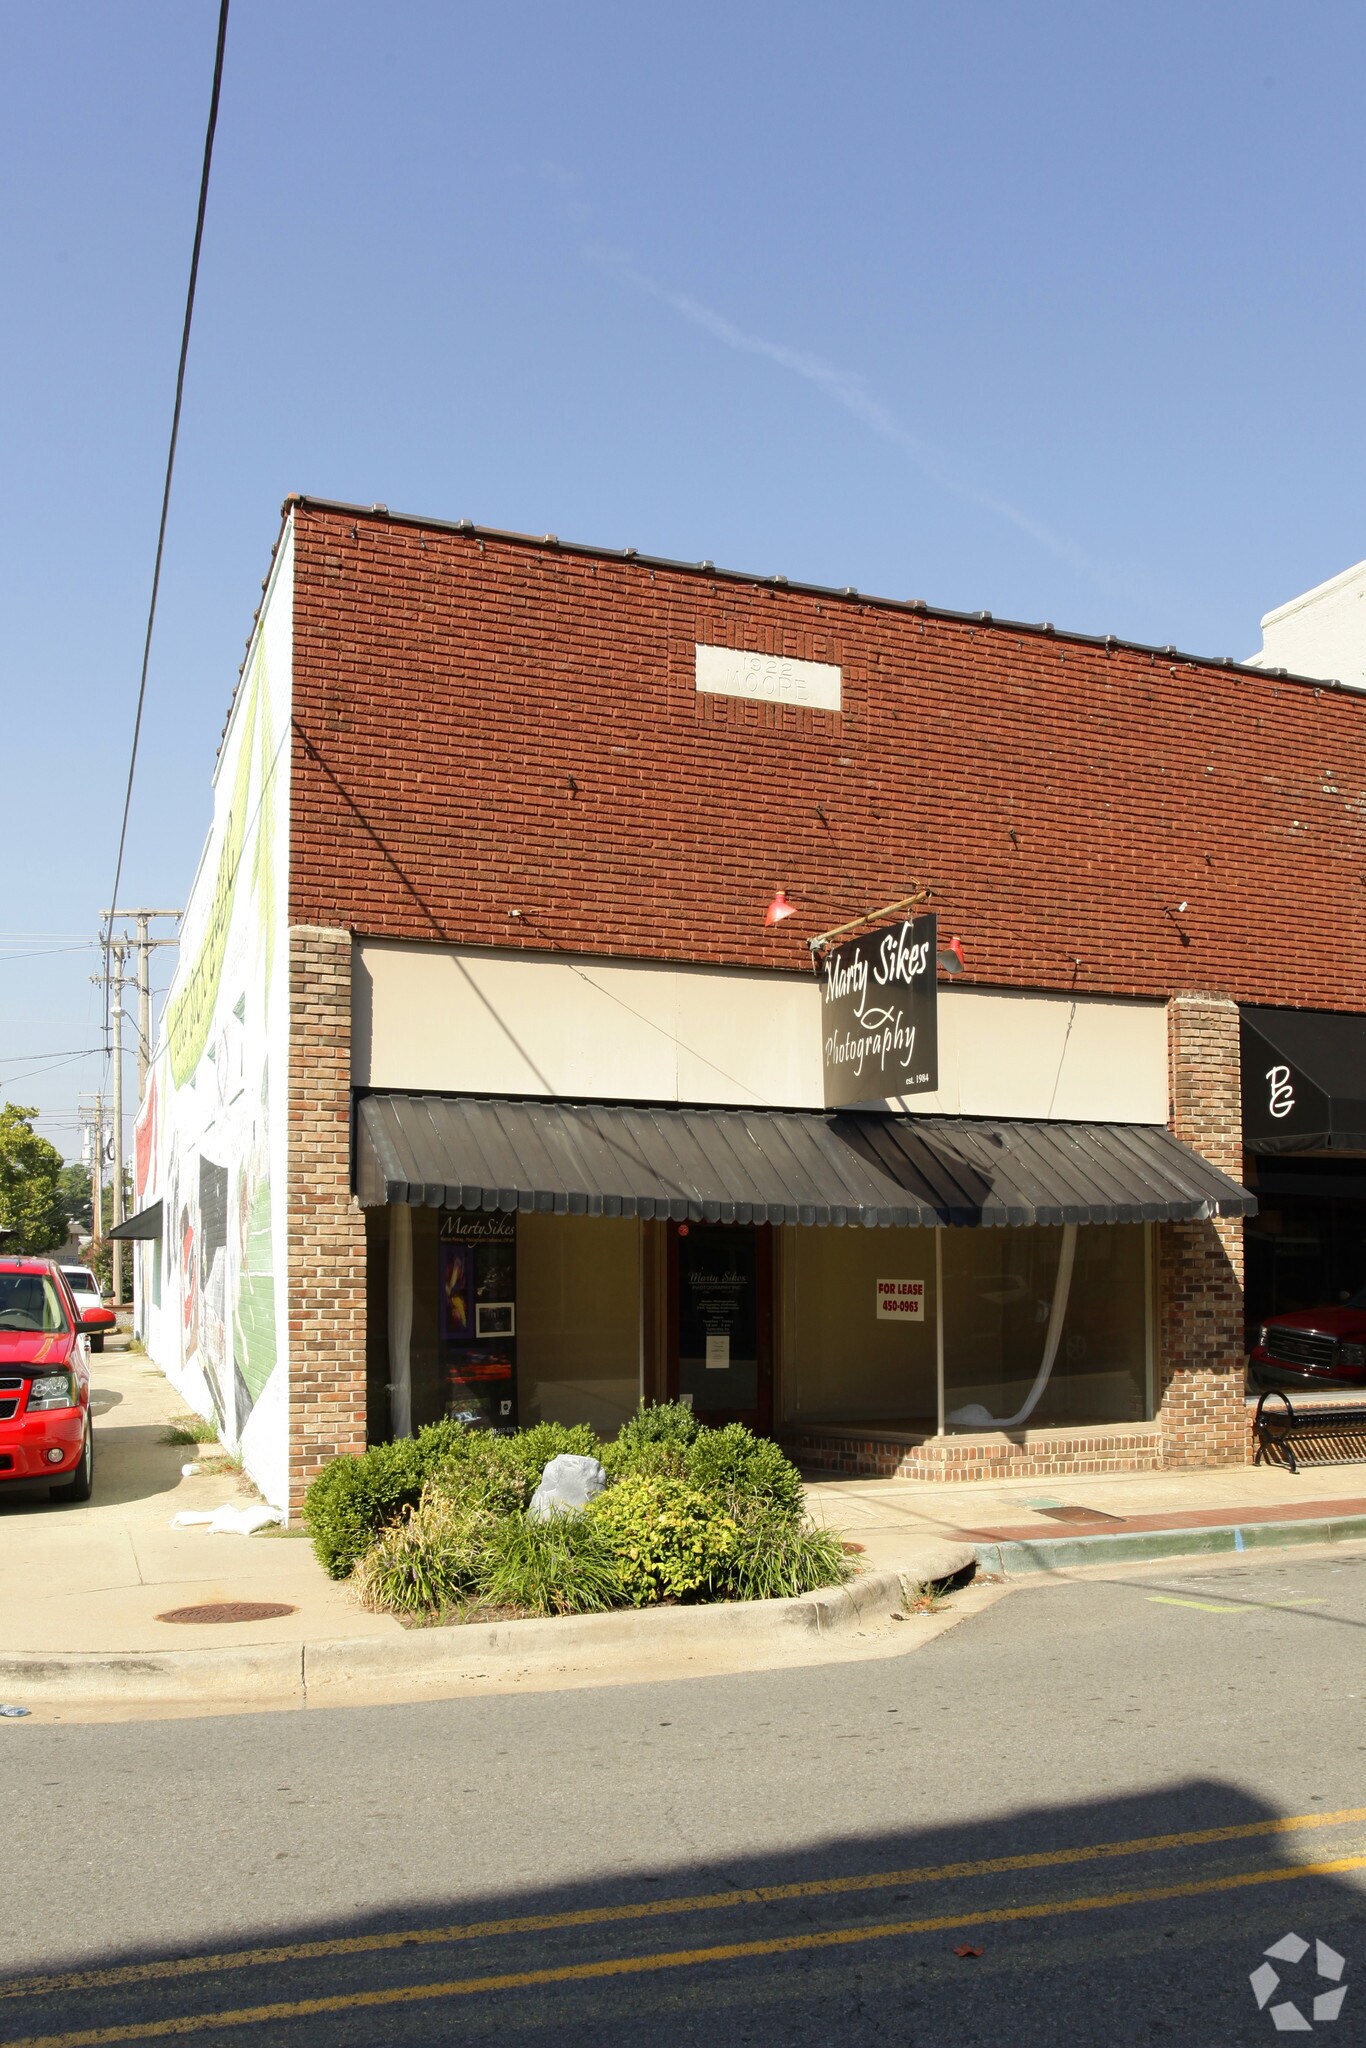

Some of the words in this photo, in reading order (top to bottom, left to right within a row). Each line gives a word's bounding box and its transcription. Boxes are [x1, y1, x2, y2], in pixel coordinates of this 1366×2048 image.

[743, 657, 793, 676] 1922
[825, 948, 868, 1018] Marty
[873, 920, 929, 984] Sikes
[825, 1011, 916, 1077] Photography
[905, 1077, 914, 1085] est.
[915, 1073, 929, 1083] 1984
[878, 1283, 896, 1294] FOR
[898, 1284, 923, 1295] LEASE
[883, 1300, 918, 1312] 450-0963
